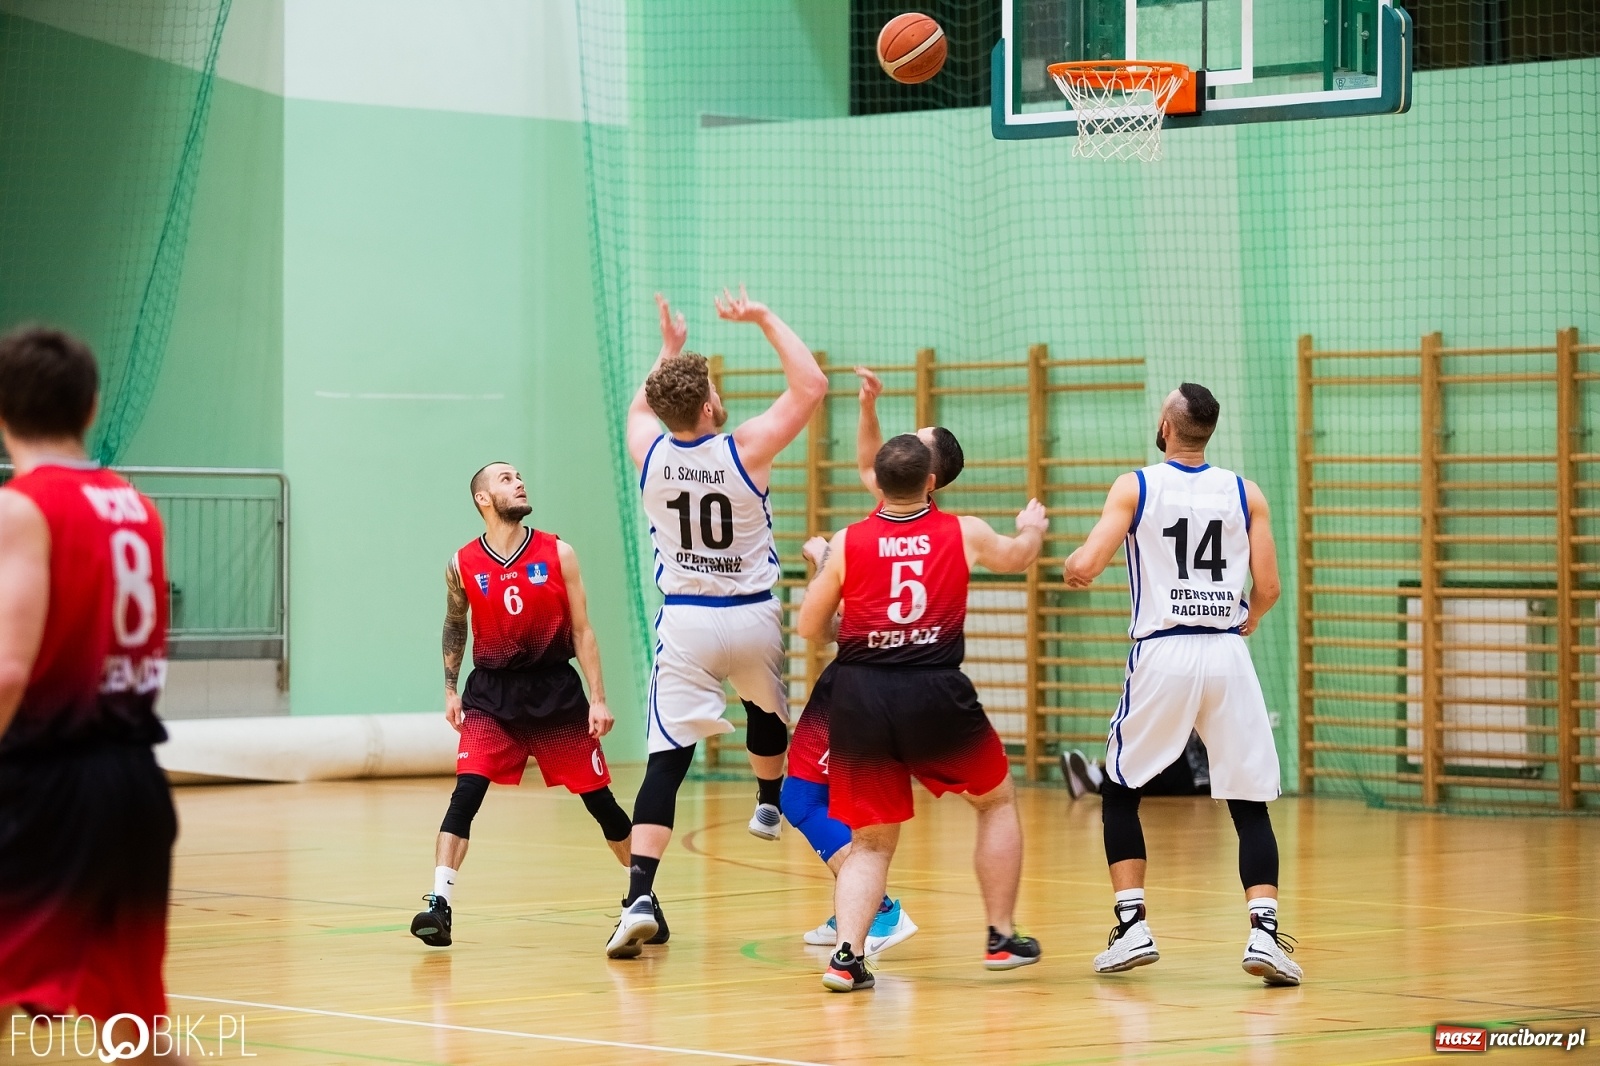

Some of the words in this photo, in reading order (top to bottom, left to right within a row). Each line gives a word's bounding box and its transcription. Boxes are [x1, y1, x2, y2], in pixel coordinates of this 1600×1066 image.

[664, 466, 675, 480] O.
[666, 491, 734, 550] 10
[878, 534, 931, 557] MCKS
[1162, 517, 1227, 582] 14
[110, 528, 157, 648] 8
[503, 585, 524, 615] 6
[887, 560, 928, 624] 5
[1170, 588, 1234, 601] OFENSYWA
[1171, 602, 1232, 617] RACIBÓRZ
